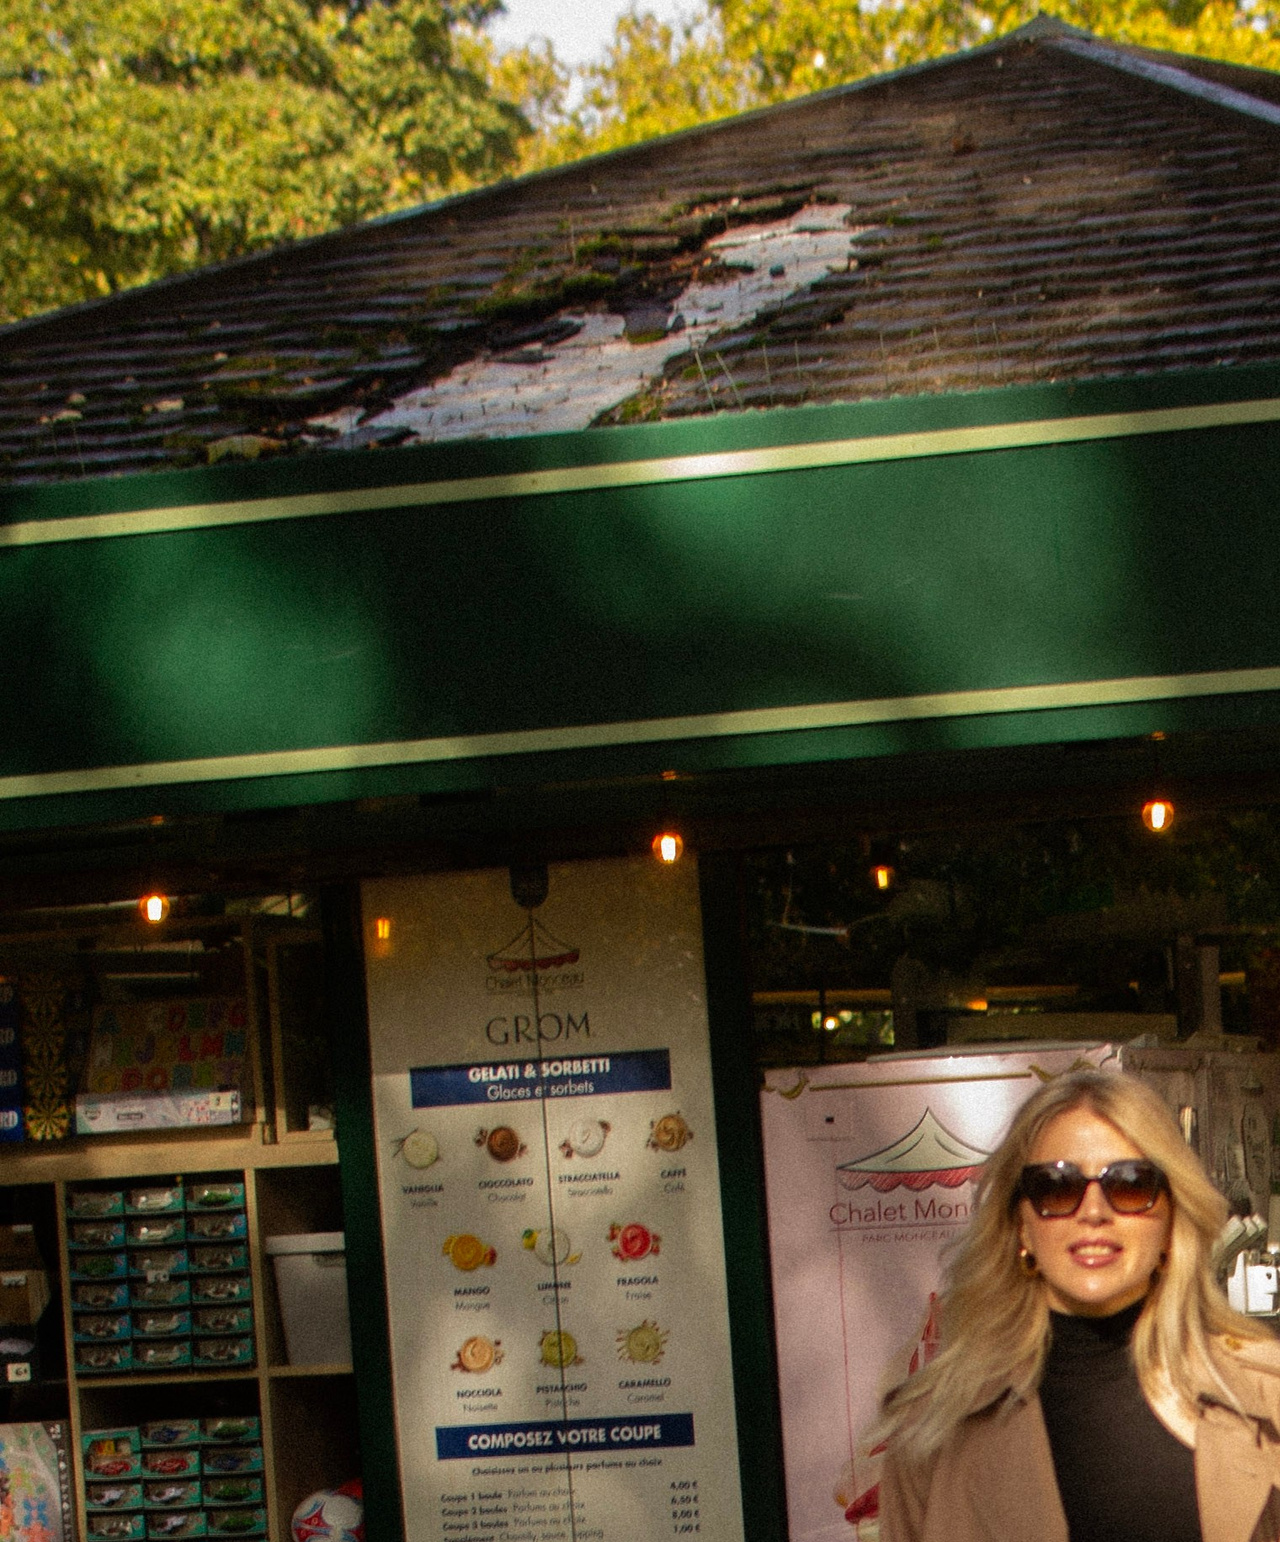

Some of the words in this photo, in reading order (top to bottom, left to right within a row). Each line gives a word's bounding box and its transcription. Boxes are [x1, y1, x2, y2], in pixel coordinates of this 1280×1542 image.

[485, 1011, 590, 1045] GROM
[468, 1065, 520, 1083] GELATI
[524, 1064, 536, 1079] &
[541, 1057, 611, 1077] SORBETTI
[486, 1083, 532, 1101] Glaces
[550, 1077, 594, 1096] sorbets
[402, 1184, 444, 1195] VANIGLIA
[478, 1177, 534, 1190] CIOCCOLATO
[558, 1171, 620, 1184] STRACCIATELLA
[829, 1200, 907, 1224] Chalet
[915, 1198, 969, 1220] Mon
[862, 1231, 891, 1243] PARC
[895, 1229, 956, 1243] MONCEAU
[453, 1285, 491, 1296] MANGO
[537, 1280, 572, 1291] LIMNE
[616, 1275, 659, 1286] FRAGOLA
[456, 1387, 503, 1399] NOCCIOLA
[618, 1377, 672, 1389] CARAMELLO
[467, 1430, 553, 1450] COMPOSEZ
[557, 1428, 606, 1445] VOTRE
[610, 1425, 662, 1441] COUPE
[586, 1460, 622, 1472] parfums
[639, 1457, 662, 1467] choix
[440, 1494, 467, 1504] Coupe
[478, 1491, 503, 1501] boule
[441, 1507, 468, 1518] Coupe
[479, 1504, 508, 1515] boules
[562, 1499, 585, 1509] chix
[442, 1522, 469, 1532] Coupe
[480, 1519, 509, 1530] boules
[563, 1514, 586, 1524] chix
[571, 1529, 604, 1541] opping
